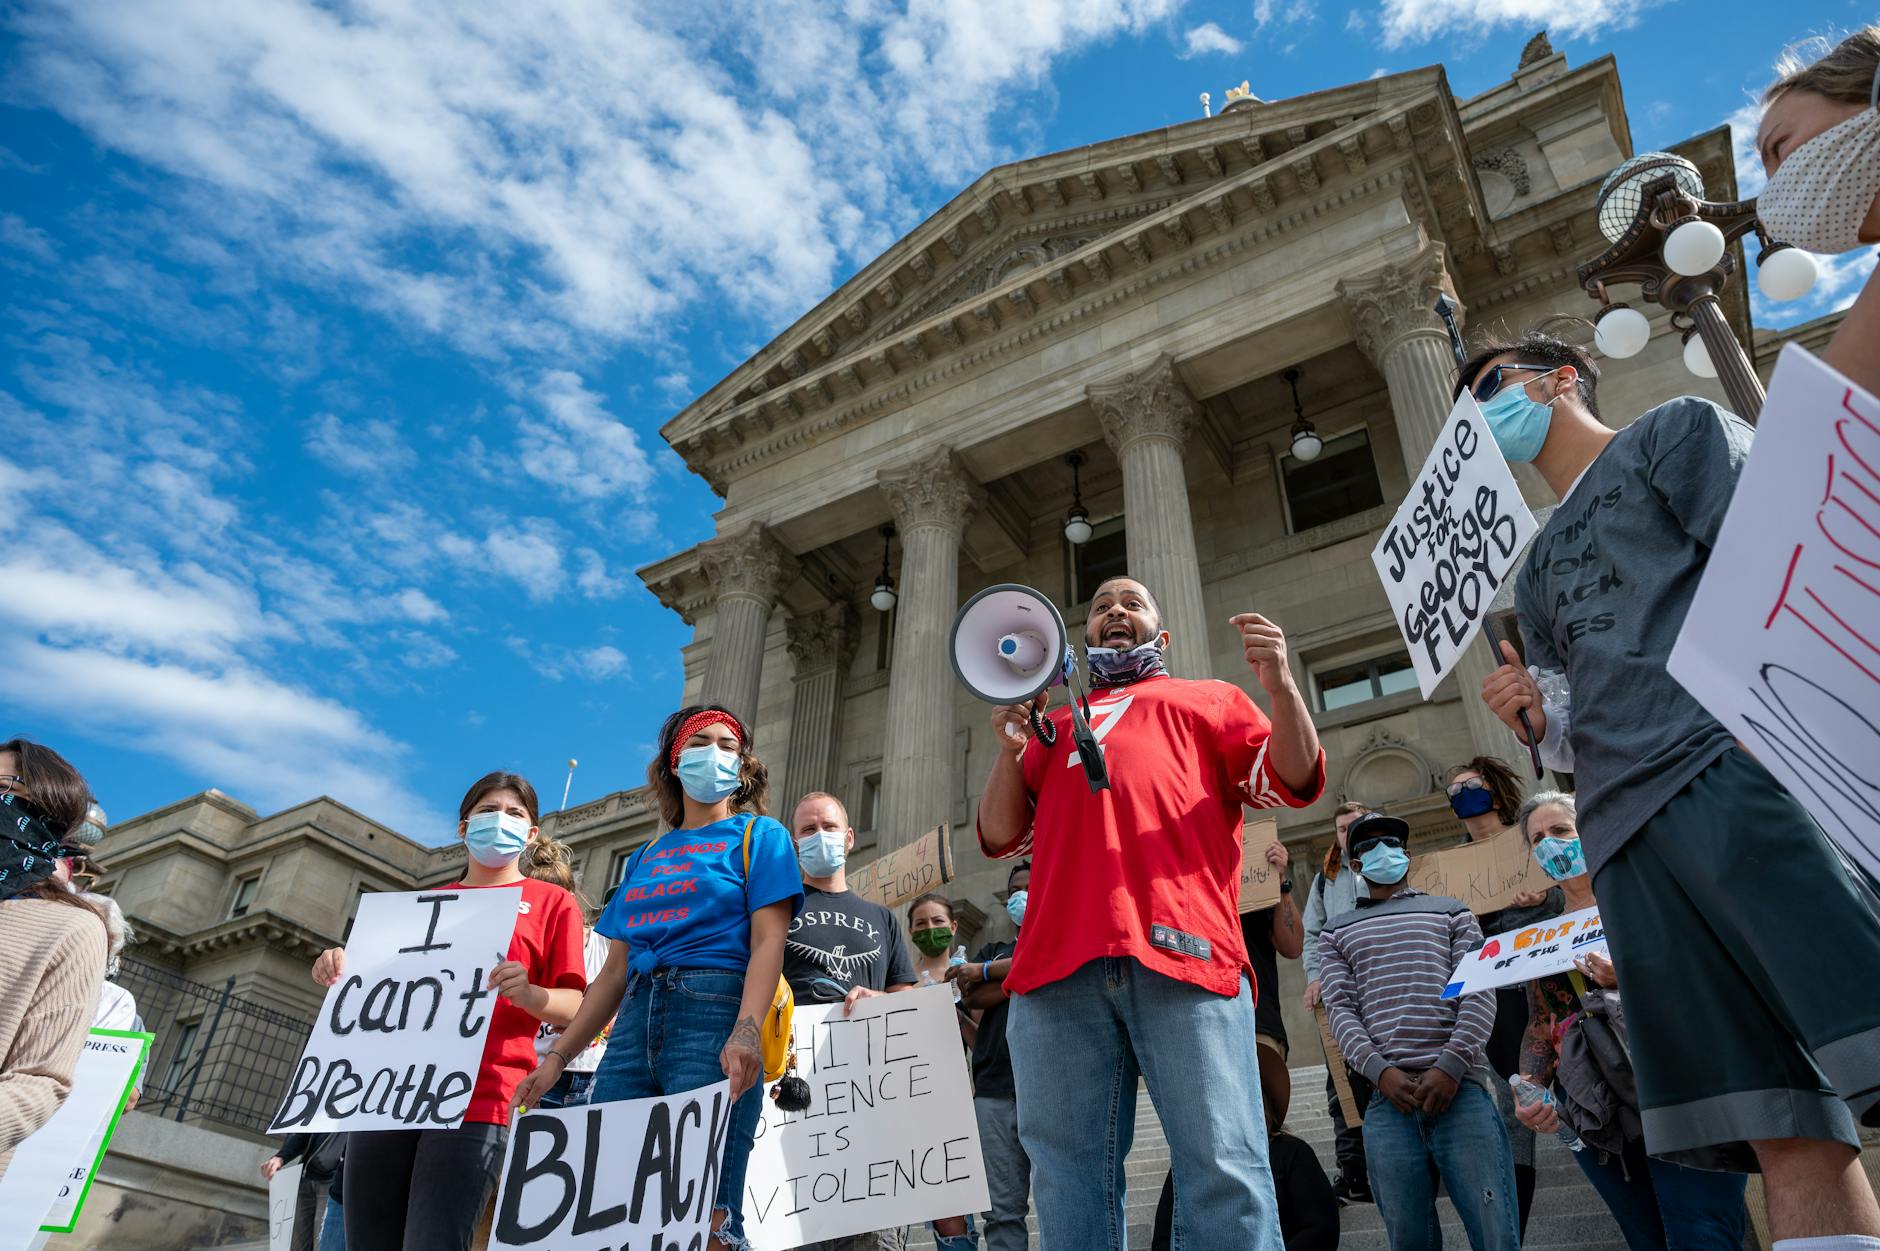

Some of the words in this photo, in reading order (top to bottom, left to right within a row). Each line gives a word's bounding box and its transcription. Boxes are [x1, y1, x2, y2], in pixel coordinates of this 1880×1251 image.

[1383, 419, 1478, 583] Justice
[1549, 485, 1622, 545] TINOS
[1427, 505, 1461, 562] FOR
[1423, 514, 1517, 675] FLOYD
[1553, 563, 1623, 618] ACK
[1067, 694, 1135, 768] 7
[642, 841, 728, 864] LATINOS
[917, 838, 928, 863] 4
[624, 878, 699, 902] BLACK
[879, 863, 934, 905] FLOYD
[398, 894, 459, 954] I
[626, 907, 690, 928] LIVES
[1494, 954, 1521, 970] OF
[1528, 943, 1560, 959] THE
[794, 1008, 918, 1075] HITE
[495, 1090, 732, 1246] BLACK
[808, 1125, 850, 1158] IS
[748, 1136, 970, 1224] VIOLENCE
